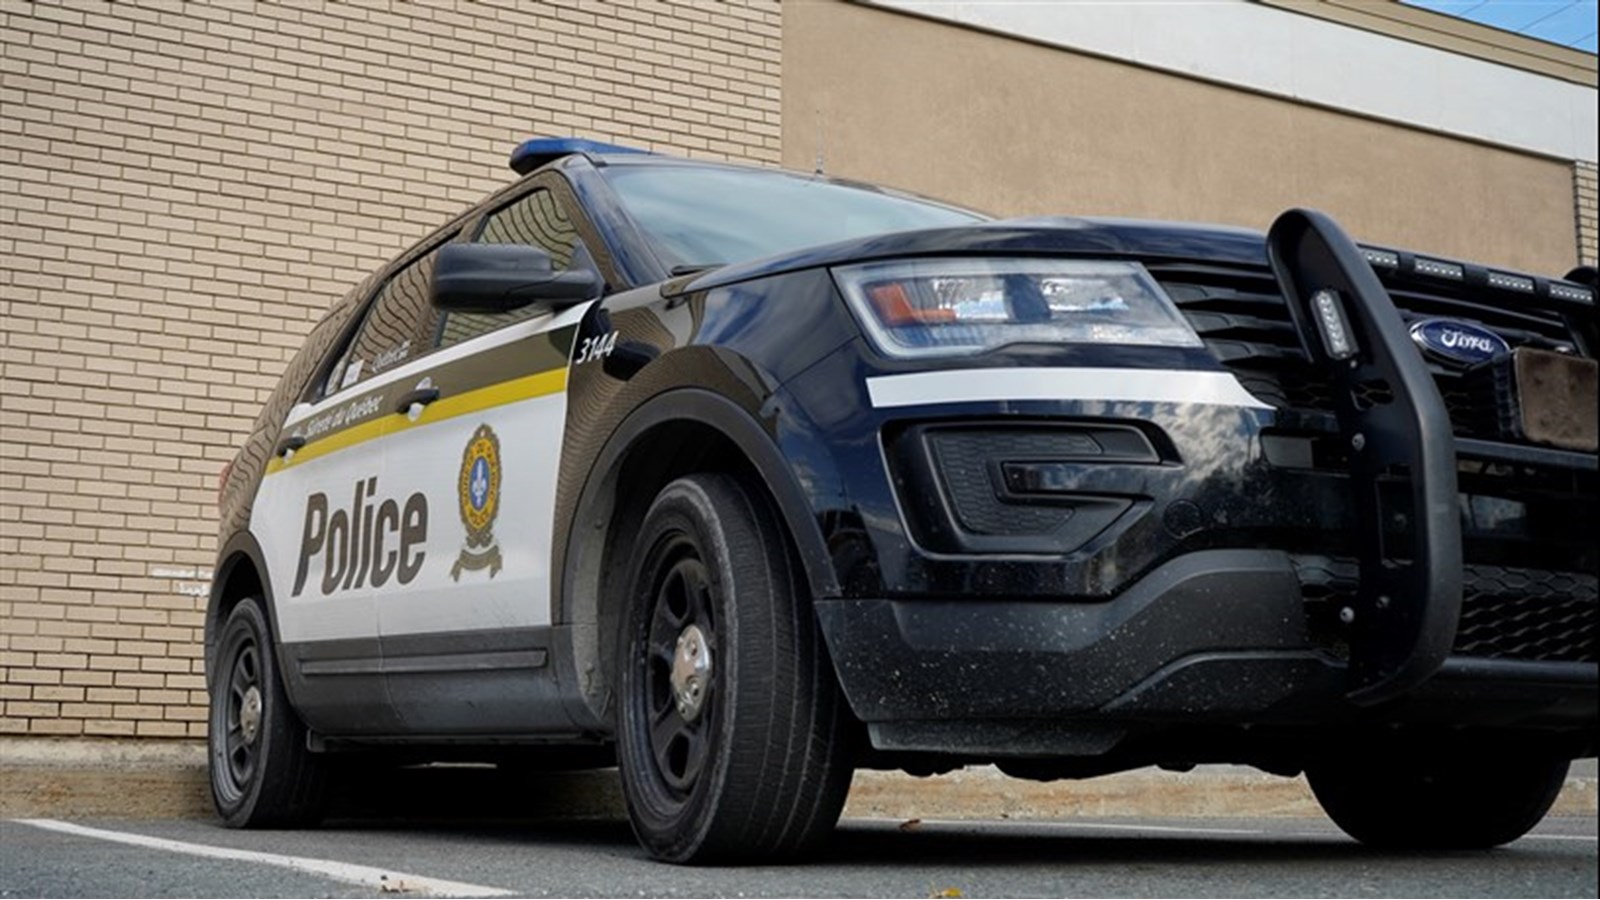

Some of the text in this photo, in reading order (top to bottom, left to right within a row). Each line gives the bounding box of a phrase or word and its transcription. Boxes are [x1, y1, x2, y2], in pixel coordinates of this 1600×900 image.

[575, 330, 619, 365] 3144
[1441, 328, 1494, 353] Ford
[291, 476, 428, 597] Police
